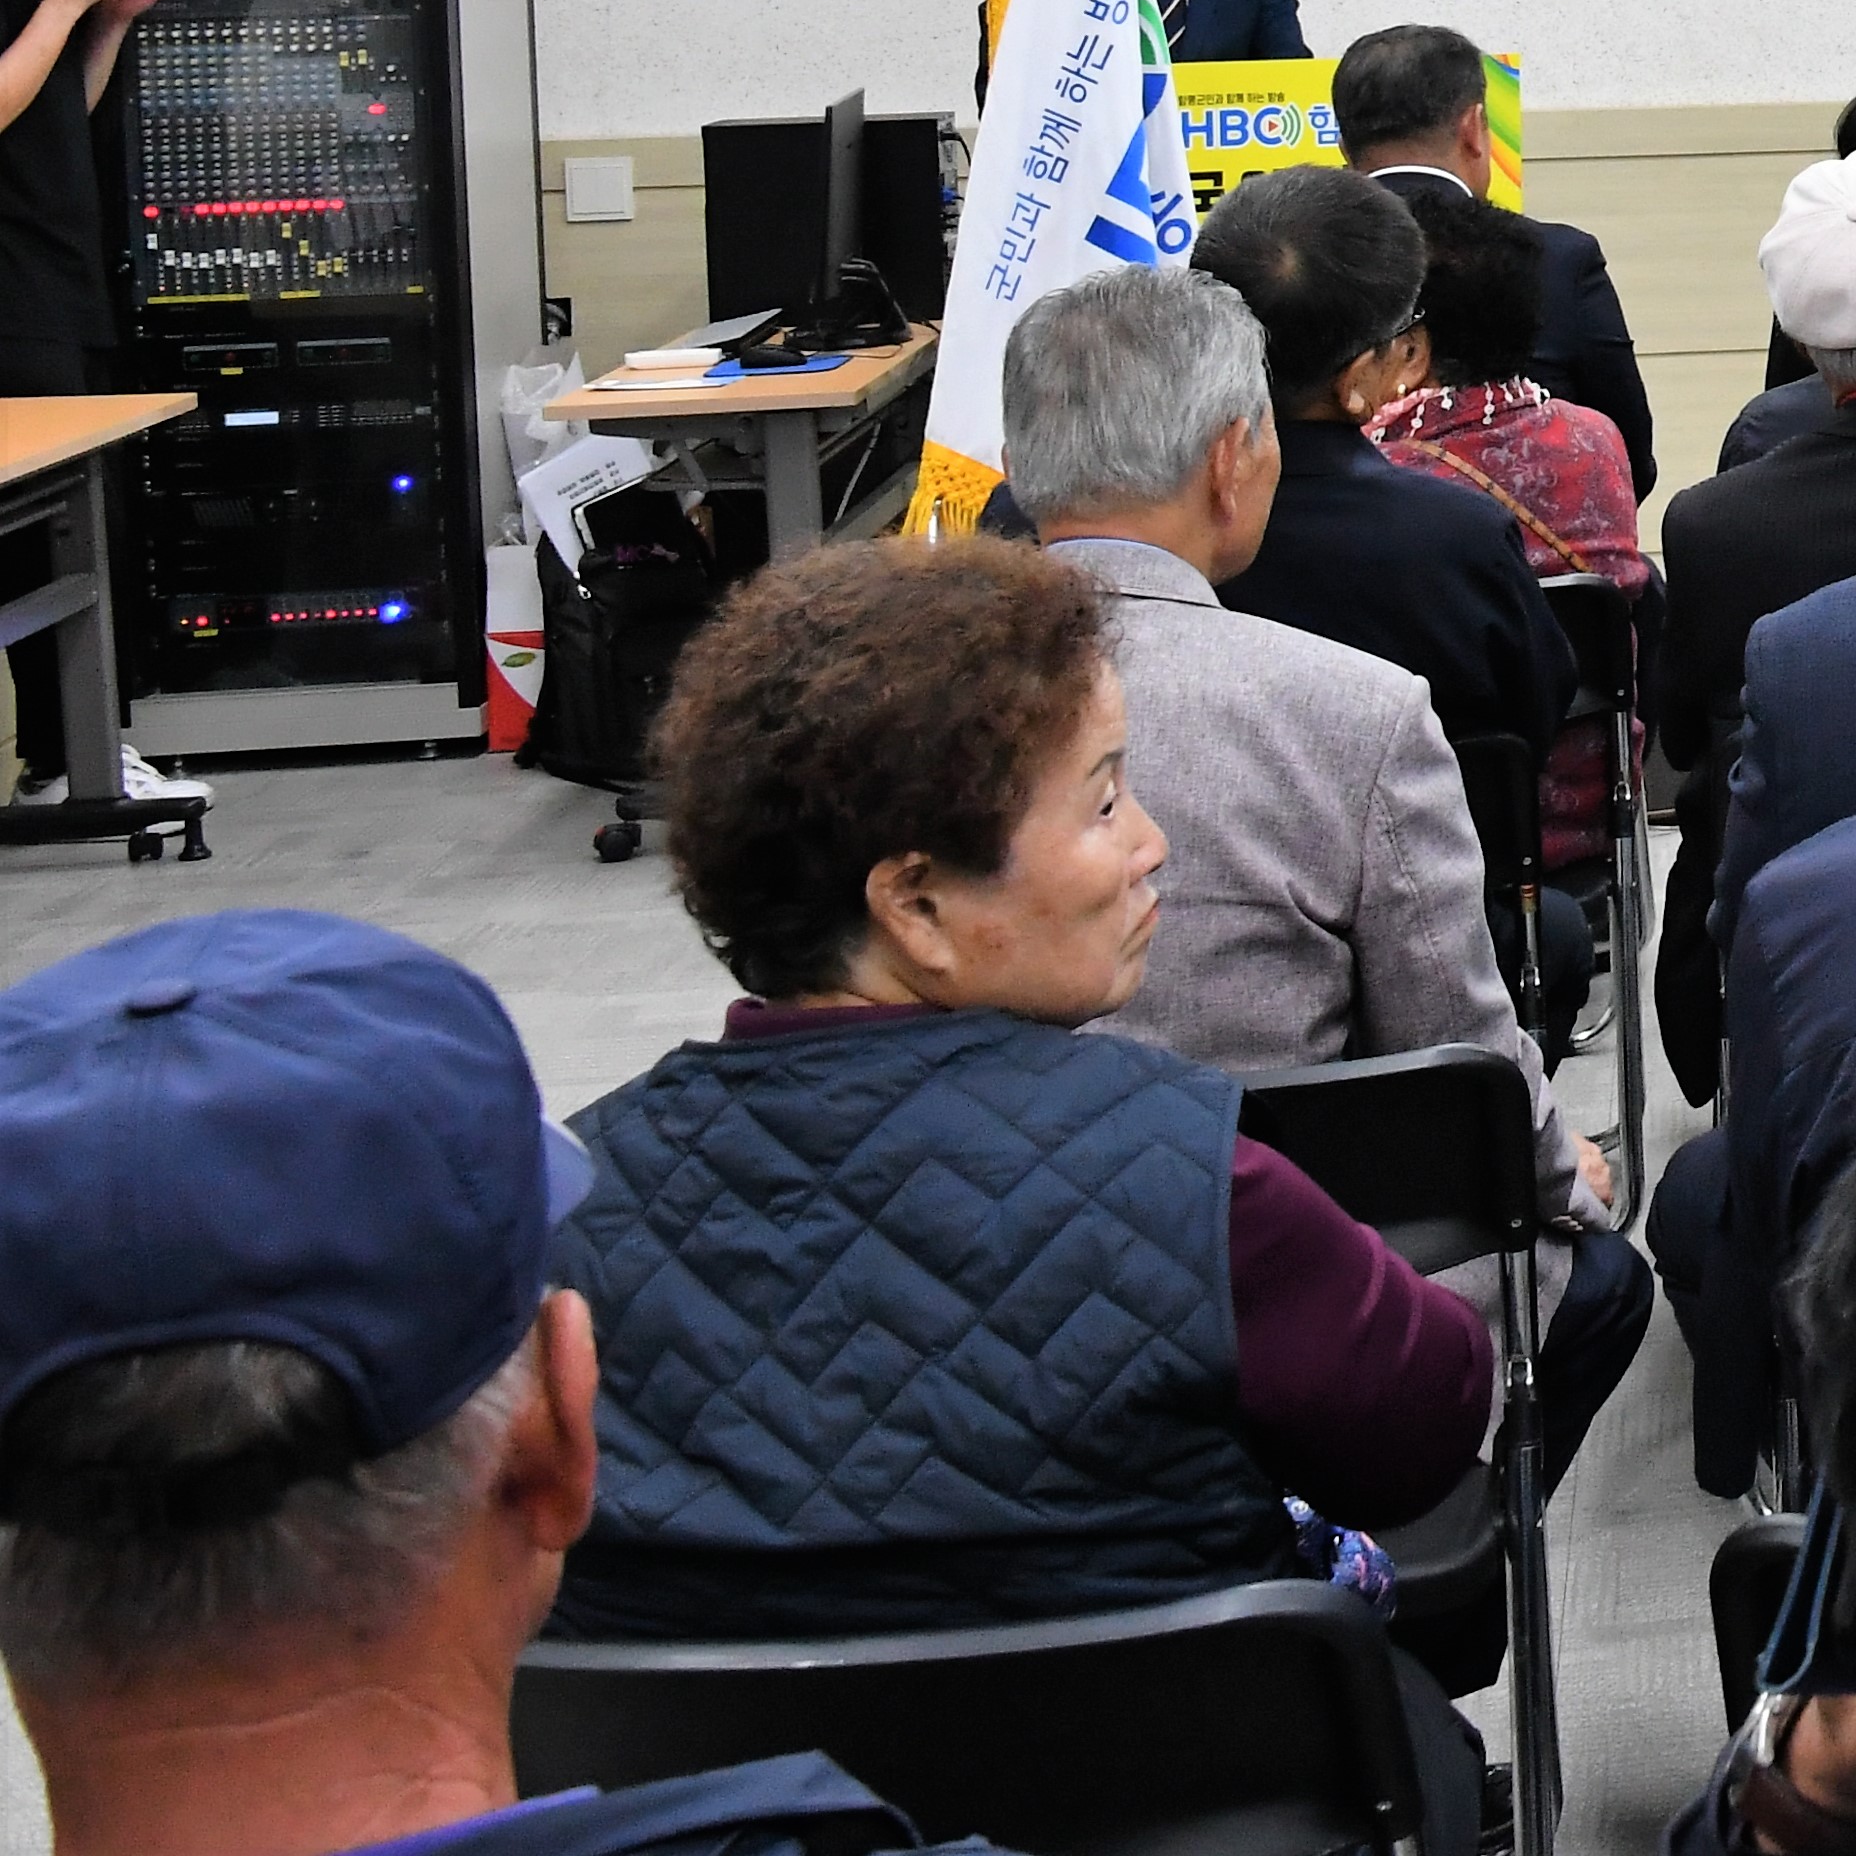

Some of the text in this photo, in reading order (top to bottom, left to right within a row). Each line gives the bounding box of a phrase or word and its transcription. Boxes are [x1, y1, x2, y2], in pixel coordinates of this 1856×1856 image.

[1023, 108, 1082, 184] 함께
[1055, 34, 1114, 104] 하는
[1182, 108, 1283, 148] HBC
